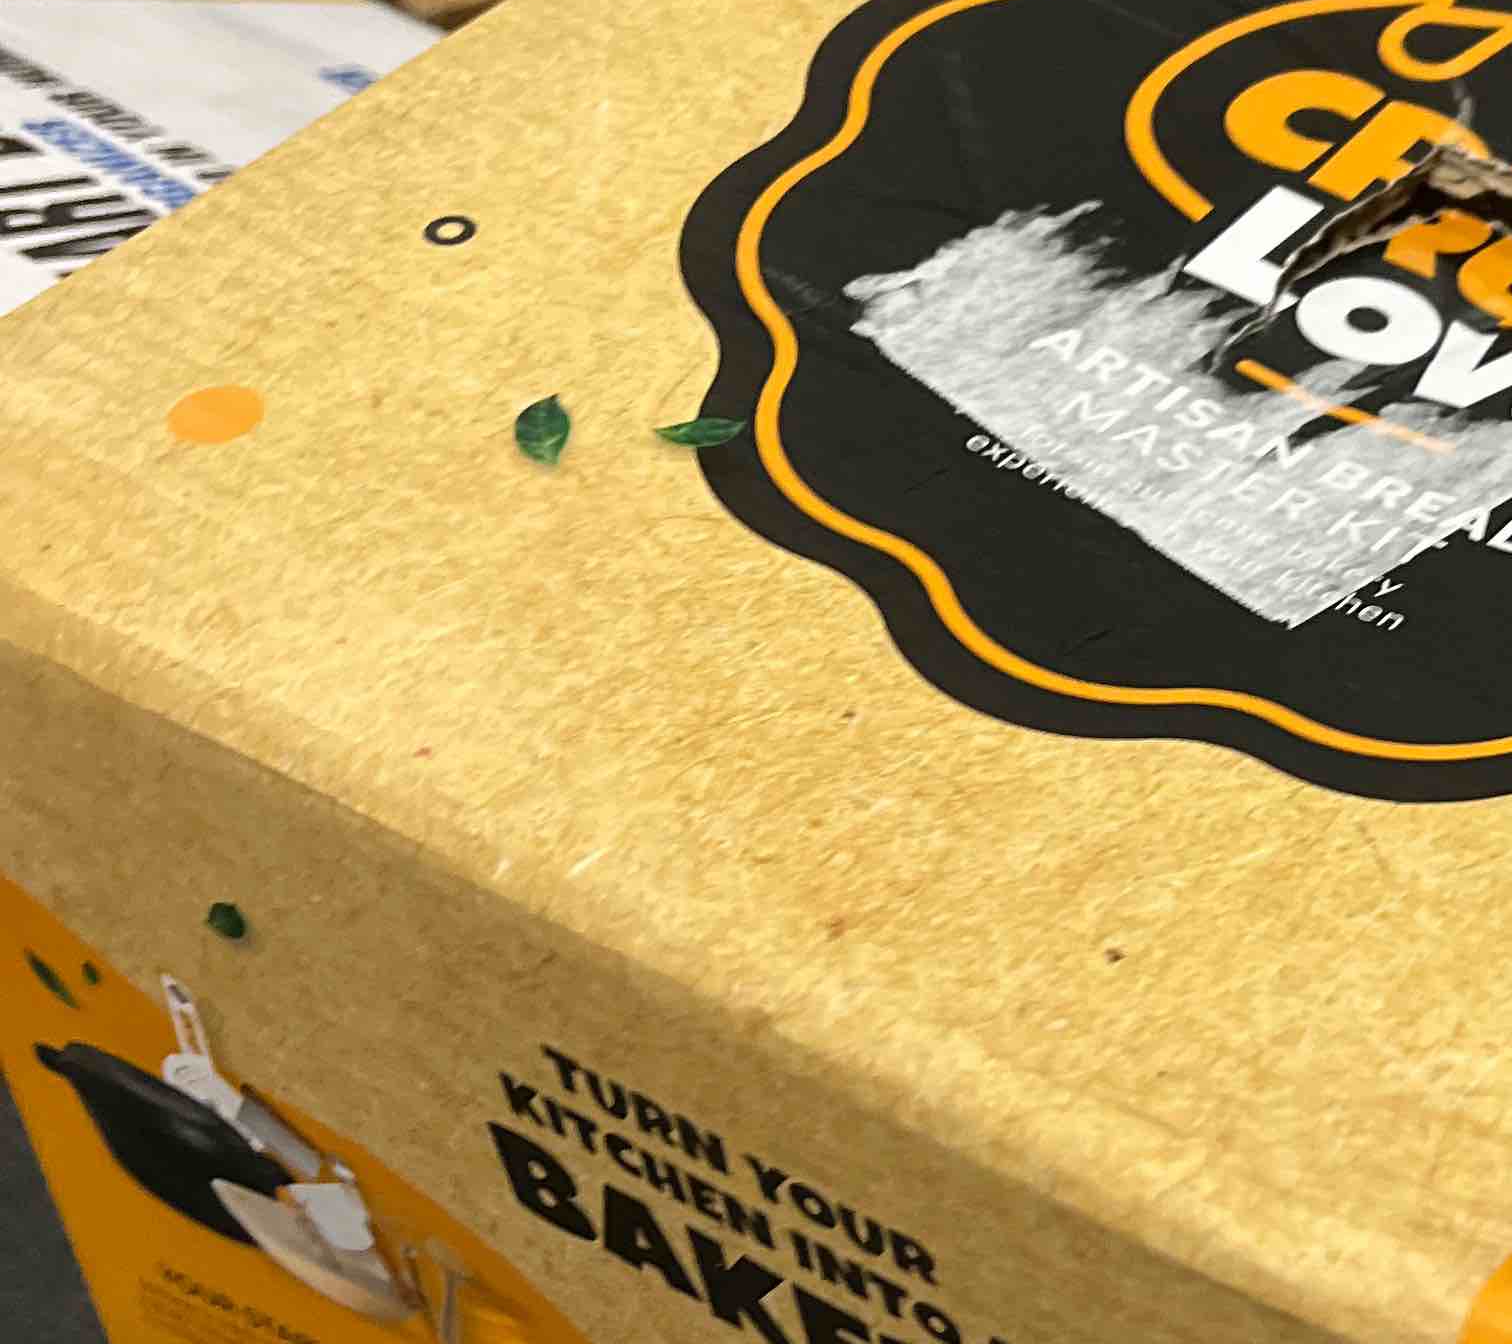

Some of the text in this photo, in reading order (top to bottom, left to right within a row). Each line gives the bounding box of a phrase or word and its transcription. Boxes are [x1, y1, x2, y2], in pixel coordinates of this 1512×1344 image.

[1028, 328, 1314, 469] ARTISAN
[1059, 392, 1320, 520] MASTER
[498, 1072, 775, 1249] KITCHEN
[540, 1043, 939, 1286] TURN YOUR
